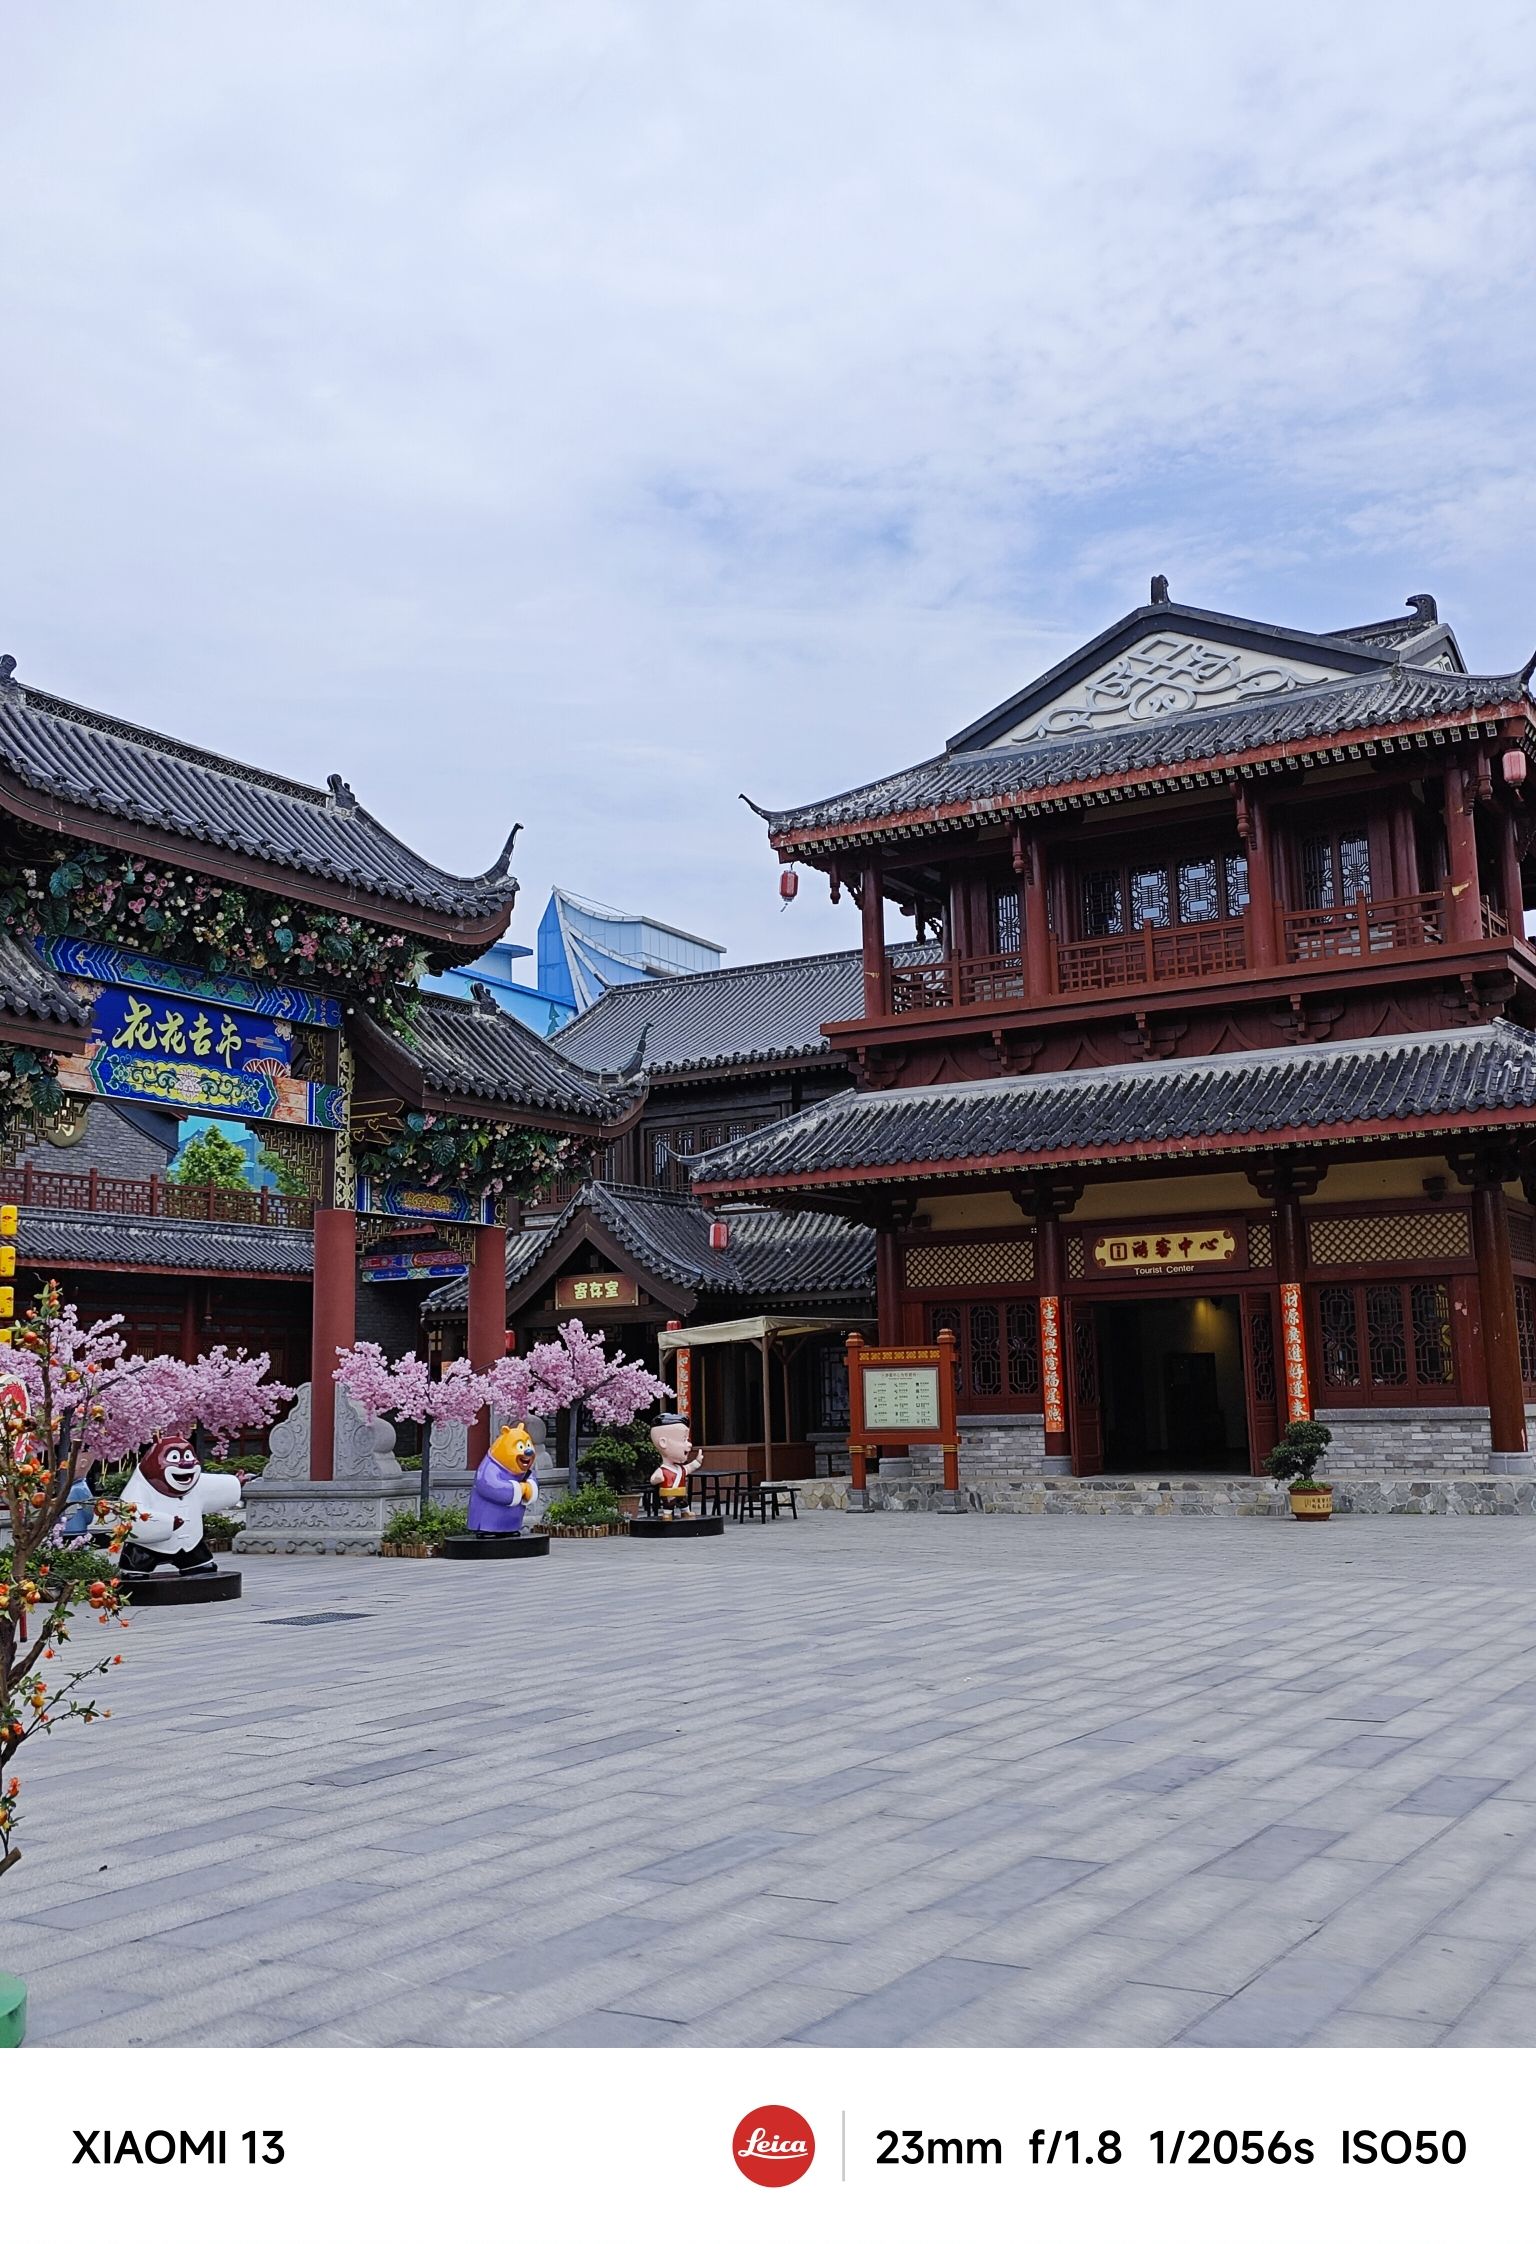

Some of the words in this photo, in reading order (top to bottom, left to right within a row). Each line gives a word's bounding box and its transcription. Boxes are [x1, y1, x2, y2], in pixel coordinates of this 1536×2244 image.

[112, 994, 242, 1070] 花花吉市
[1131, 1236, 1219, 1259] 游客中心
[1134, 1267, 1162, 1275] Tourist
[1166, 1264, 1195, 1274] Center
[574, 1280, 619, 1300] 寄存室
